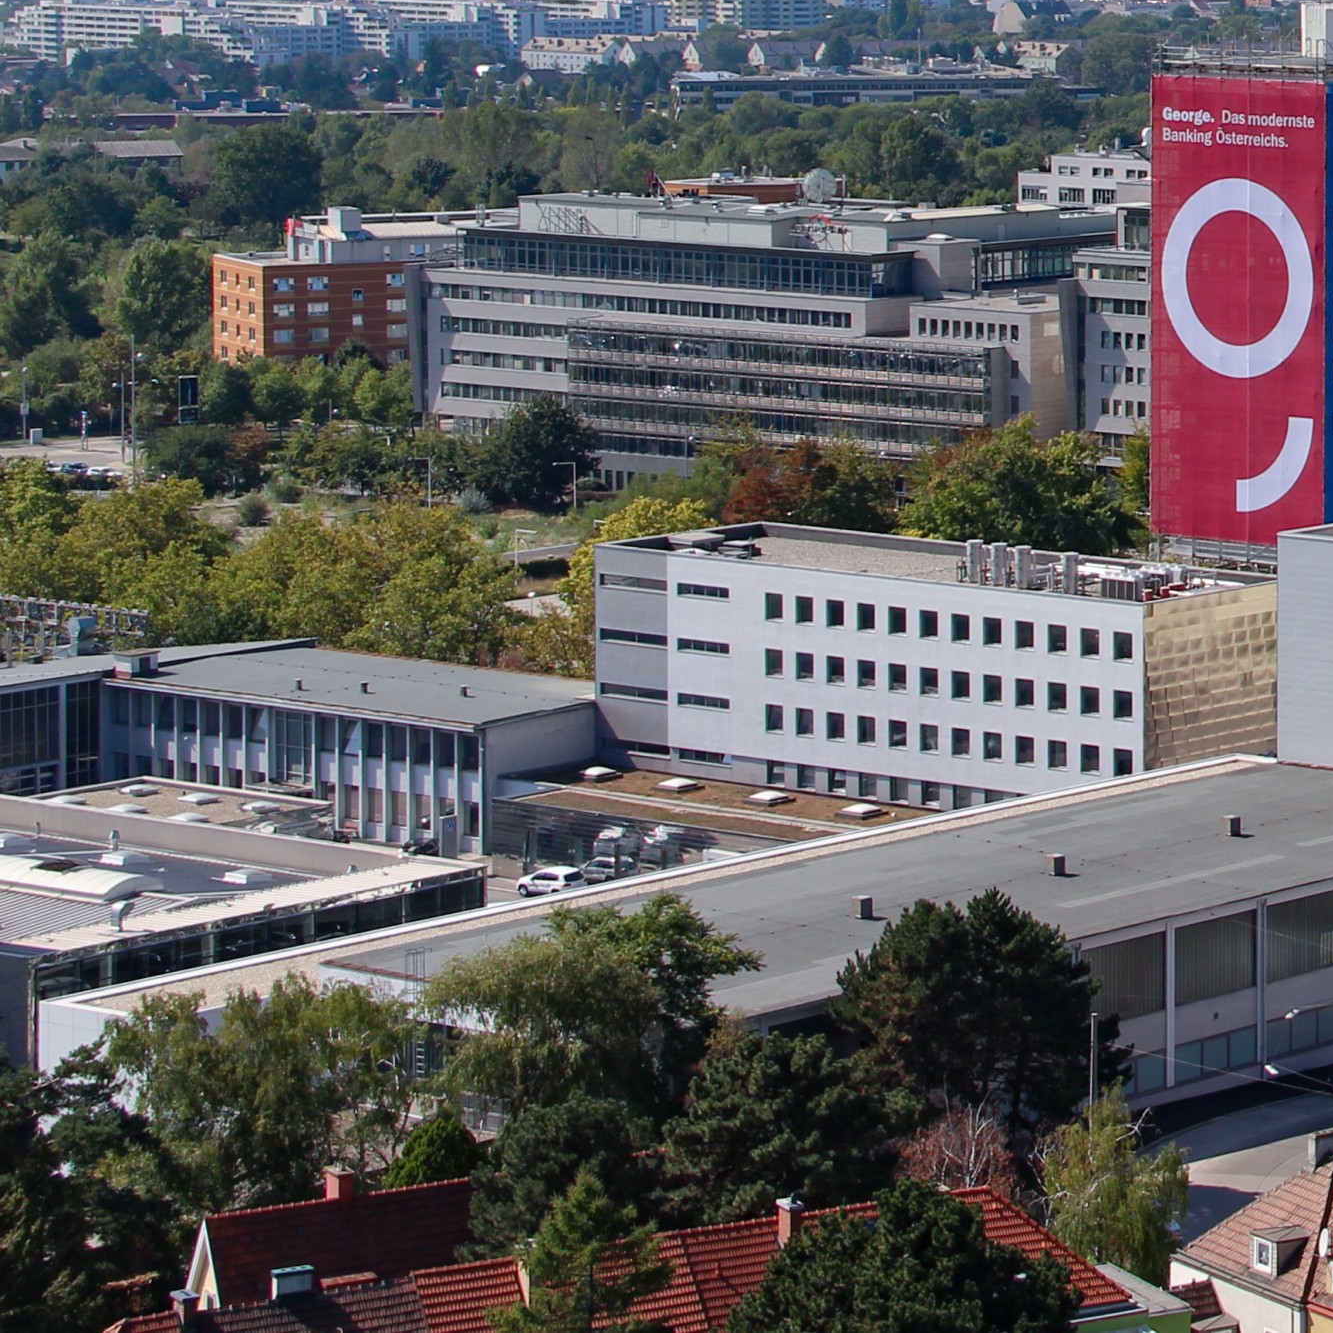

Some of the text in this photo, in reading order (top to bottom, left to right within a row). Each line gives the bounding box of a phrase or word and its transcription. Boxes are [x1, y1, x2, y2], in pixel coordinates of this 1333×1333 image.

[1162, 106, 1315, 128] George. Das modernste
[1162, 126, 1289, 148] Banking Österreichs.
